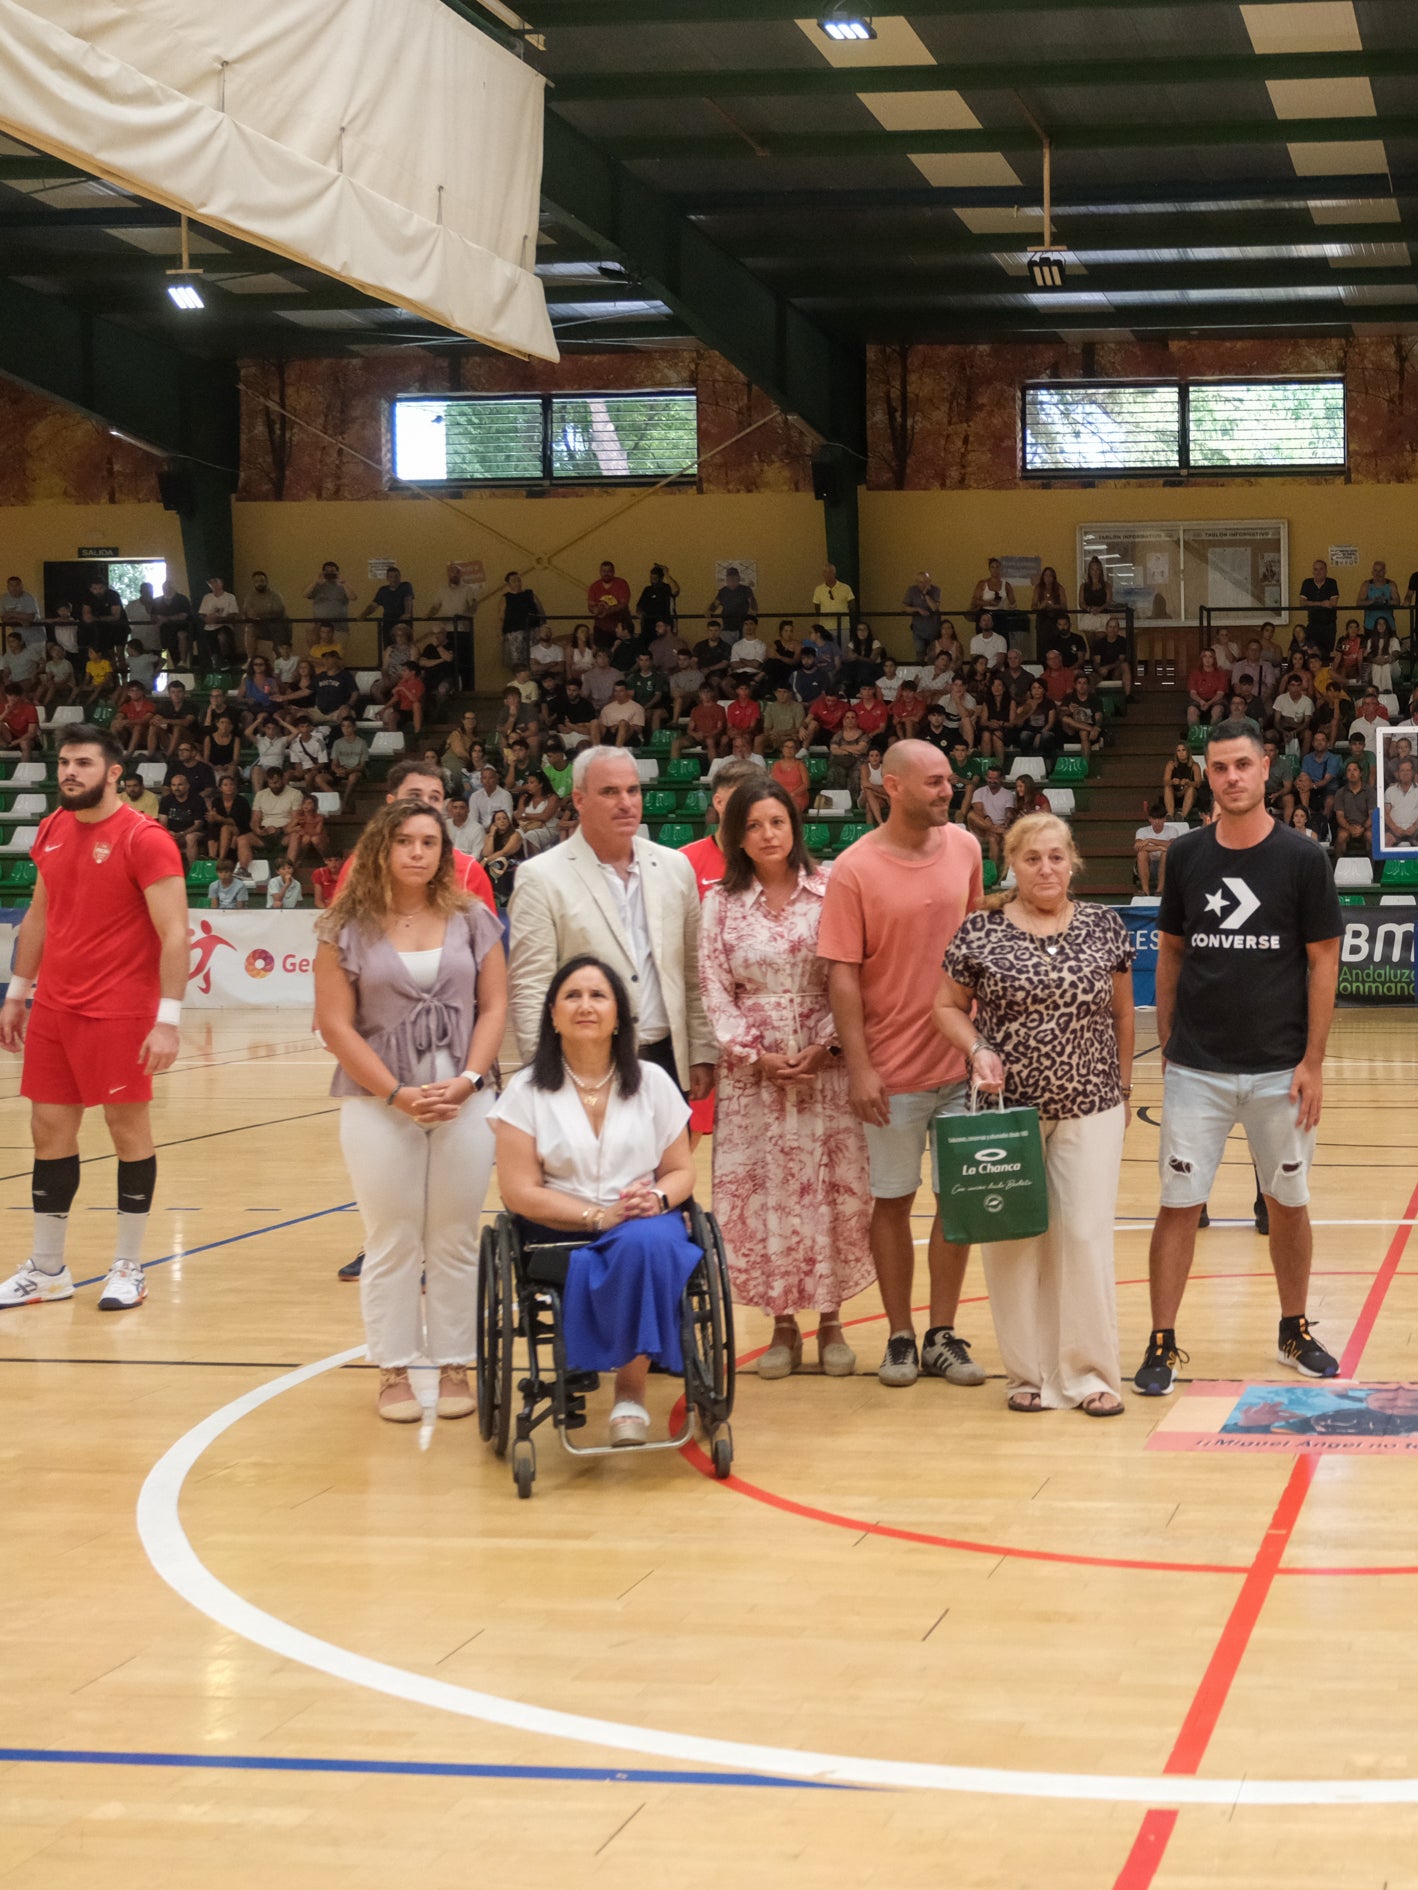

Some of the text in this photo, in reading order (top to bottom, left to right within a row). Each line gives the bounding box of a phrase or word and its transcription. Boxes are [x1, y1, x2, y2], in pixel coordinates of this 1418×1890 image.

[1191, 932, 1280, 949] CONVERSE
[962, 1162, 1021, 1176] La Chanca
[1369, 1441, 1398, 1450] no
